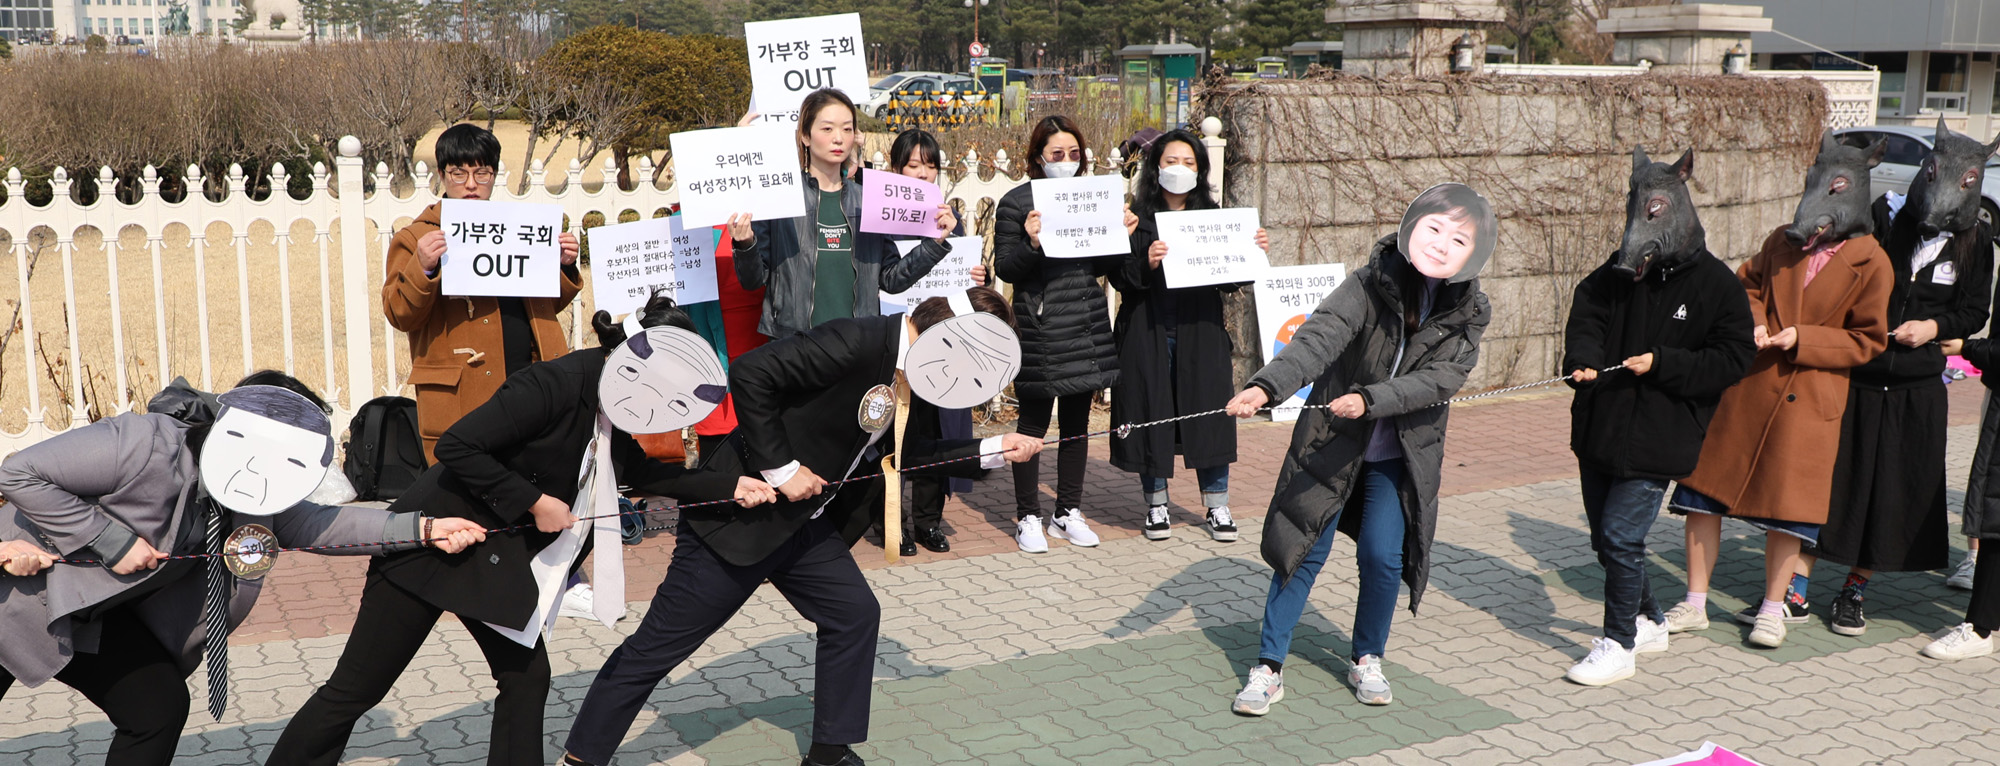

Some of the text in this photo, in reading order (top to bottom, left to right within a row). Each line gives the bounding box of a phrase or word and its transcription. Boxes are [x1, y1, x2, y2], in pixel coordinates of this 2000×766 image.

[757, 36, 856, 63] 가부장 국회
[783, 66, 837, 92] OUT
[715, 152, 764, 168] 우리에겐
[689, 172, 794, 194] 여성정치가 필요해
[884, 184, 925, 202] 51명을
[1054, 190, 1109, 202] 국회 법사위 여성
[1067, 203, 1098, 213] 2명/18명
[881, 207, 927, 224] 51%로!
[451, 221, 553, 247] 가부장 국회
[1055, 226, 1108, 238] 미투법안 통과율
[1178, 223, 1241, 233] 국회 법사위 여성
[615, 242, 640, 254] 세상의
[644, 239, 660, 250] 절반
[673, 235, 689, 245] 여성
[1075, 239, 1091, 249] 24%
[1195, 234, 1229, 243] 2명/18명
[472, 253, 530, 278] OUT
[606, 255, 639, 268] 후보자의
[643, 250, 676, 262] 절대다수
[951, 256, 964, 265] 여성
[1187, 254, 1246, 266] 미투법안 통과율
[607, 268, 640, 281] 당선자의
[644, 262, 676, 275] 절대다수
[1210, 266, 1230, 275] 24%
[925, 280, 951, 289] 절대다수
[1265, 275, 1336, 291] 국회의원 300명
[628, 286, 645, 298] 반쪽
[1280, 293, 1301, 307] 여성
[869, 401, 886, 415] 국회
